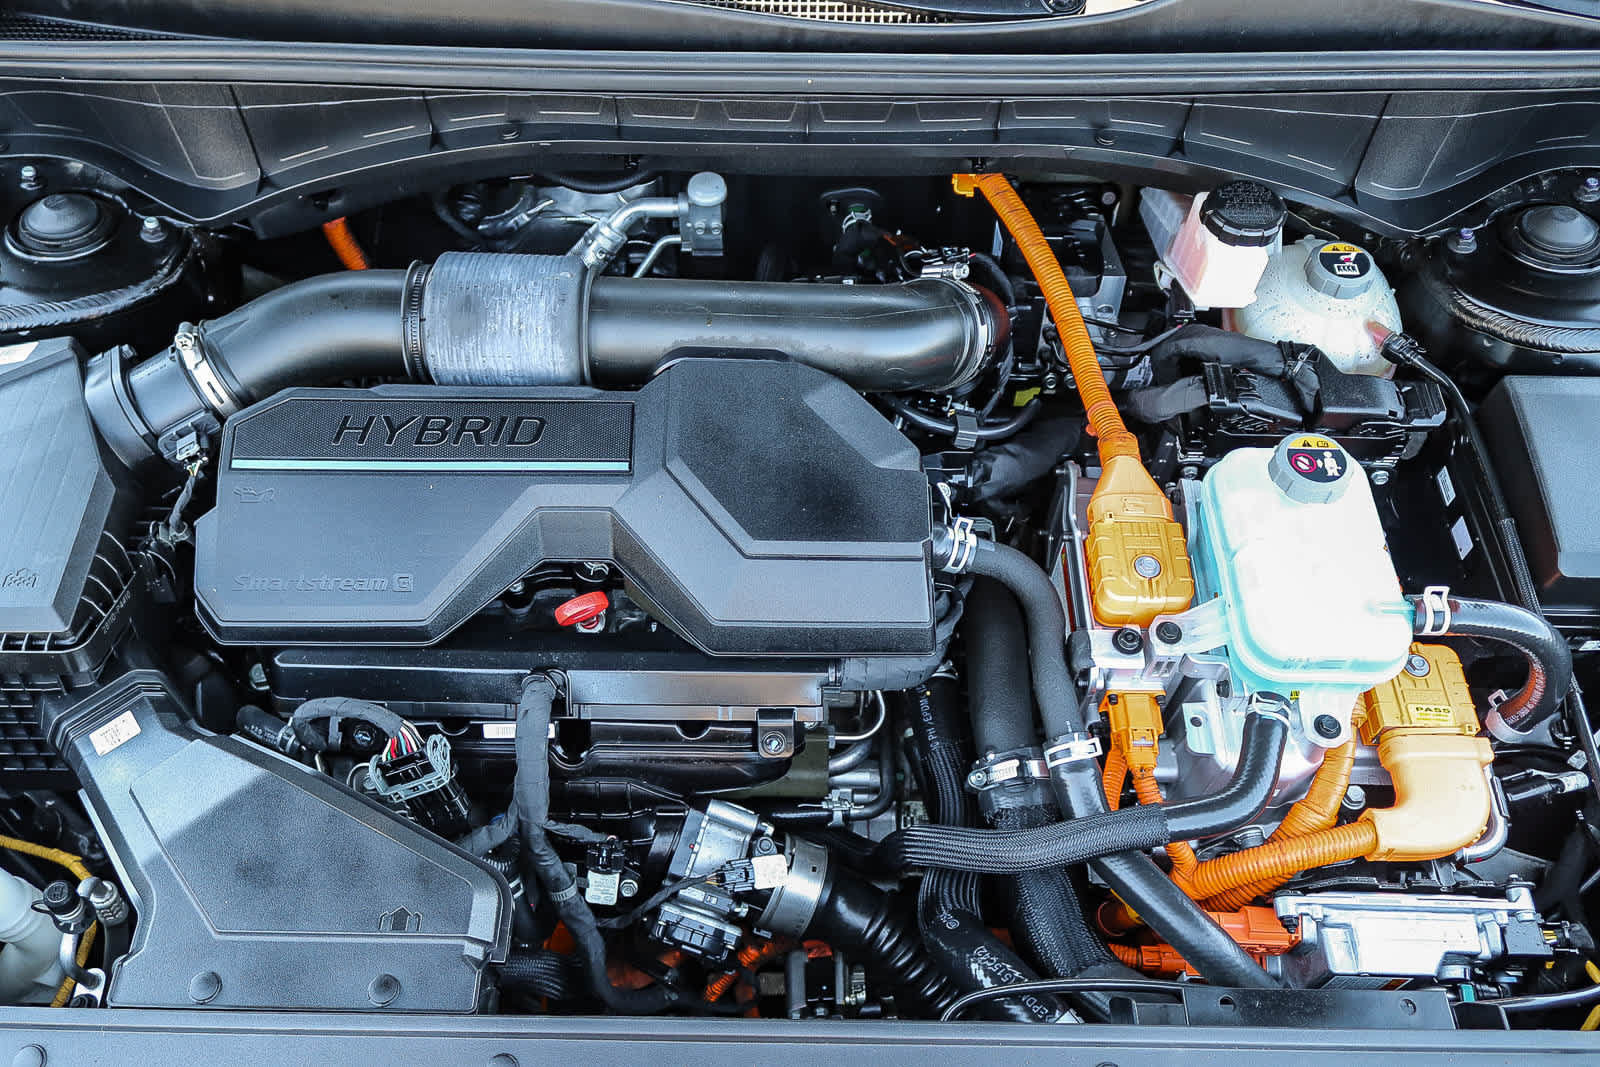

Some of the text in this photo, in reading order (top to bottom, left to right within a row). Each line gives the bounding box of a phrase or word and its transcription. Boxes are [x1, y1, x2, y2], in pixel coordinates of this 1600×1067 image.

[331, 415, 550, 447] HYBRID
[231, 574, 390, 592] Smartstream
[1415, 706, 1451, 714] PASS
